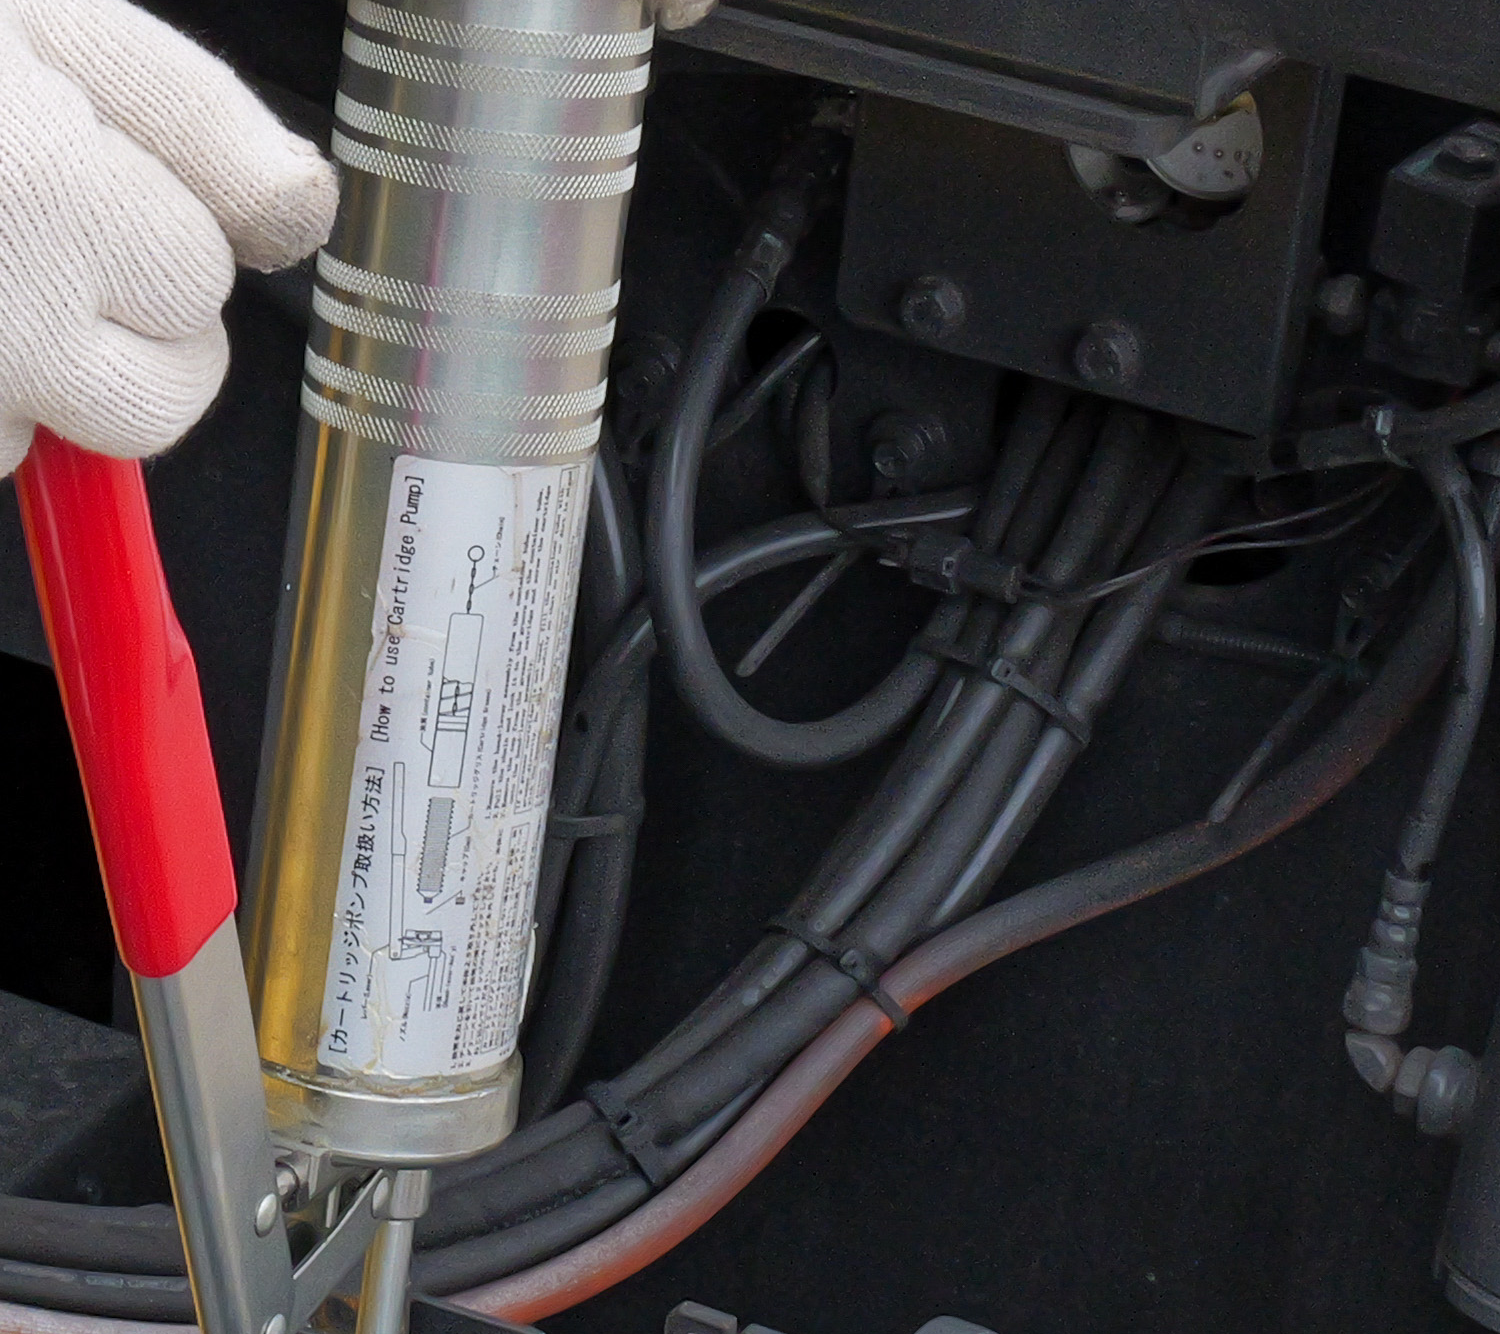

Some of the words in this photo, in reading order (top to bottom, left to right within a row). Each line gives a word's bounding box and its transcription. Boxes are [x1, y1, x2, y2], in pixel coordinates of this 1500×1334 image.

[399, 475, 424, 524] Pump]
[386, 535, 416, 625] Cartridge
[385, 635, 400, 665] use
[377, 675, 395, 693] to
[369, 704, 393, 742] [How
[327, 766, 385, 1053] [カートリッジポンプ取扱い方法]
